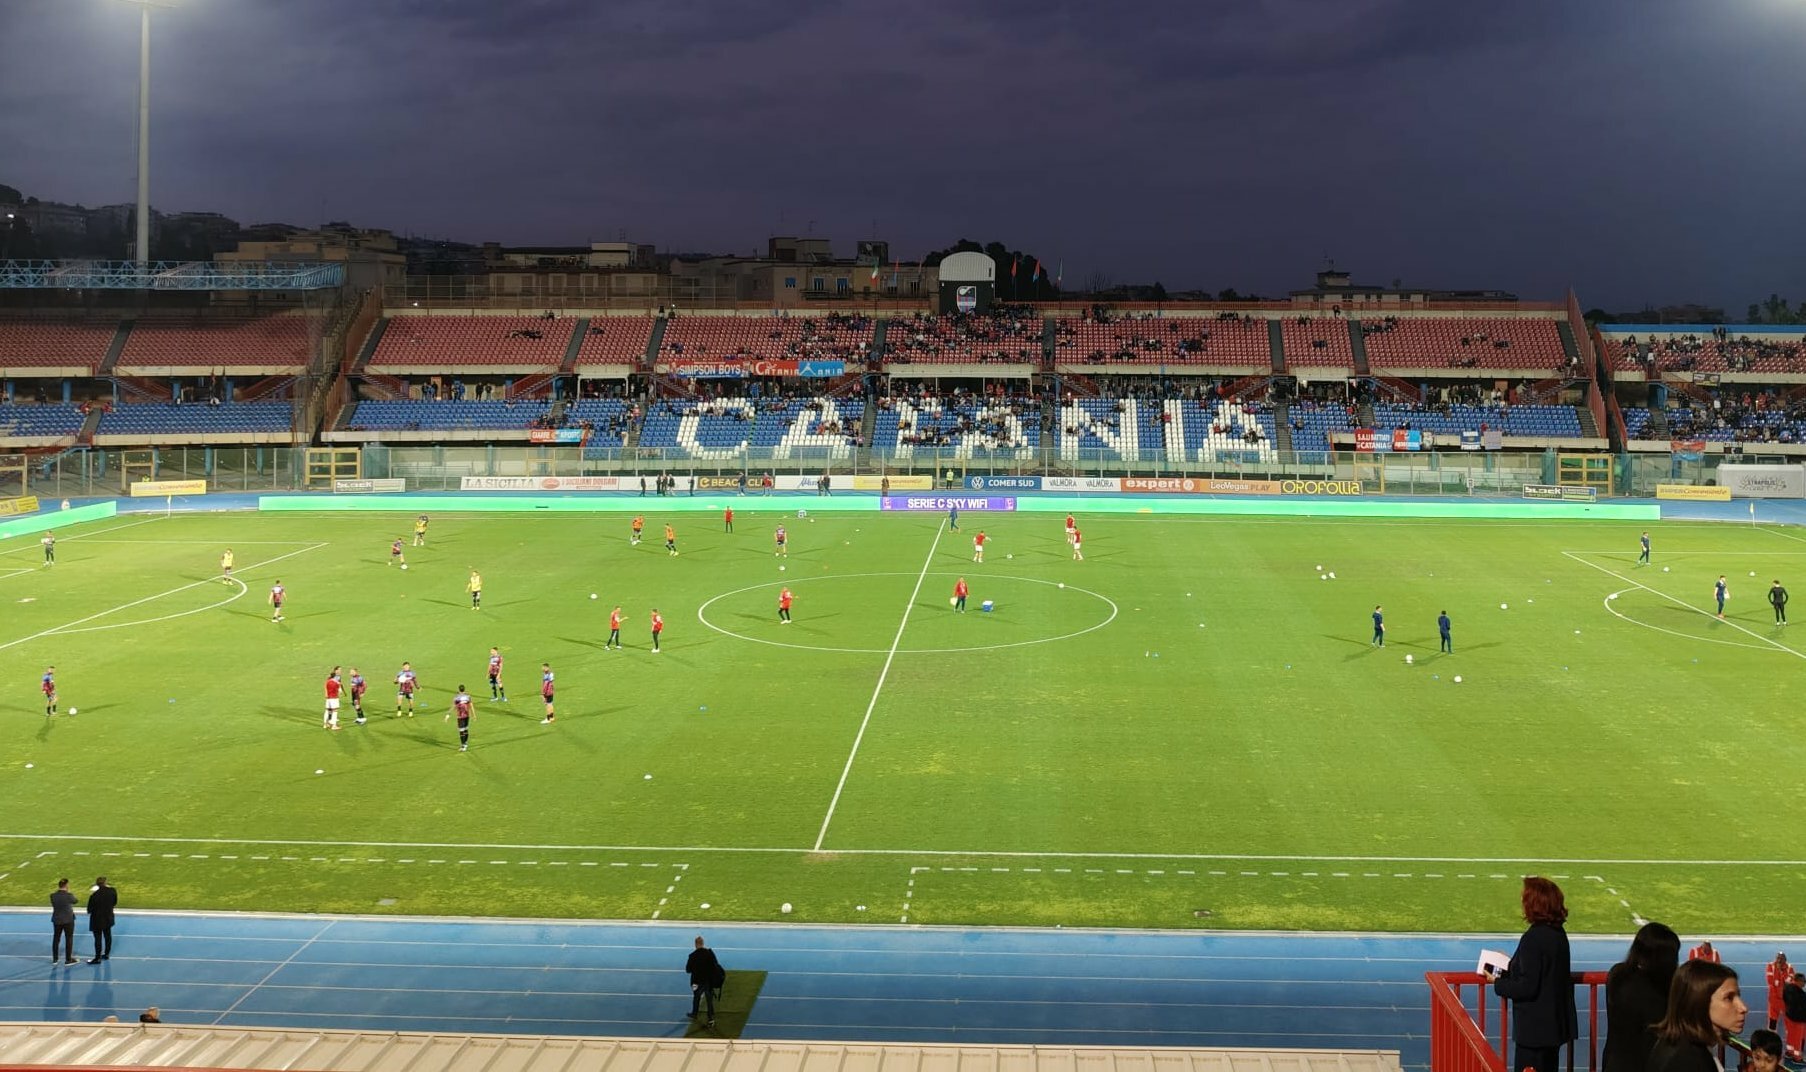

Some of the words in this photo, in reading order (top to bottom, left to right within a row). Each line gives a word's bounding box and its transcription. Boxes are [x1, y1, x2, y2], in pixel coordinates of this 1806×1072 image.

[679, 364, 716, 375] SIMPSON
[718, 364, 741, 375] BOYS
[485, 478, 533, 489] SICILIA
[711, 478, 739, 487] BEAC
[988, 479, 1015, 487] COMER
[1017, 479, 1035, 487] SUD
[1125, 479, 1181, 489] expert
[1210, 481, 1249, 491] LeoVegas
[907, 498, 936, 509] SERIE
[937, 498, 946, 509] C
[967, 498, 988, 509] WIFI
